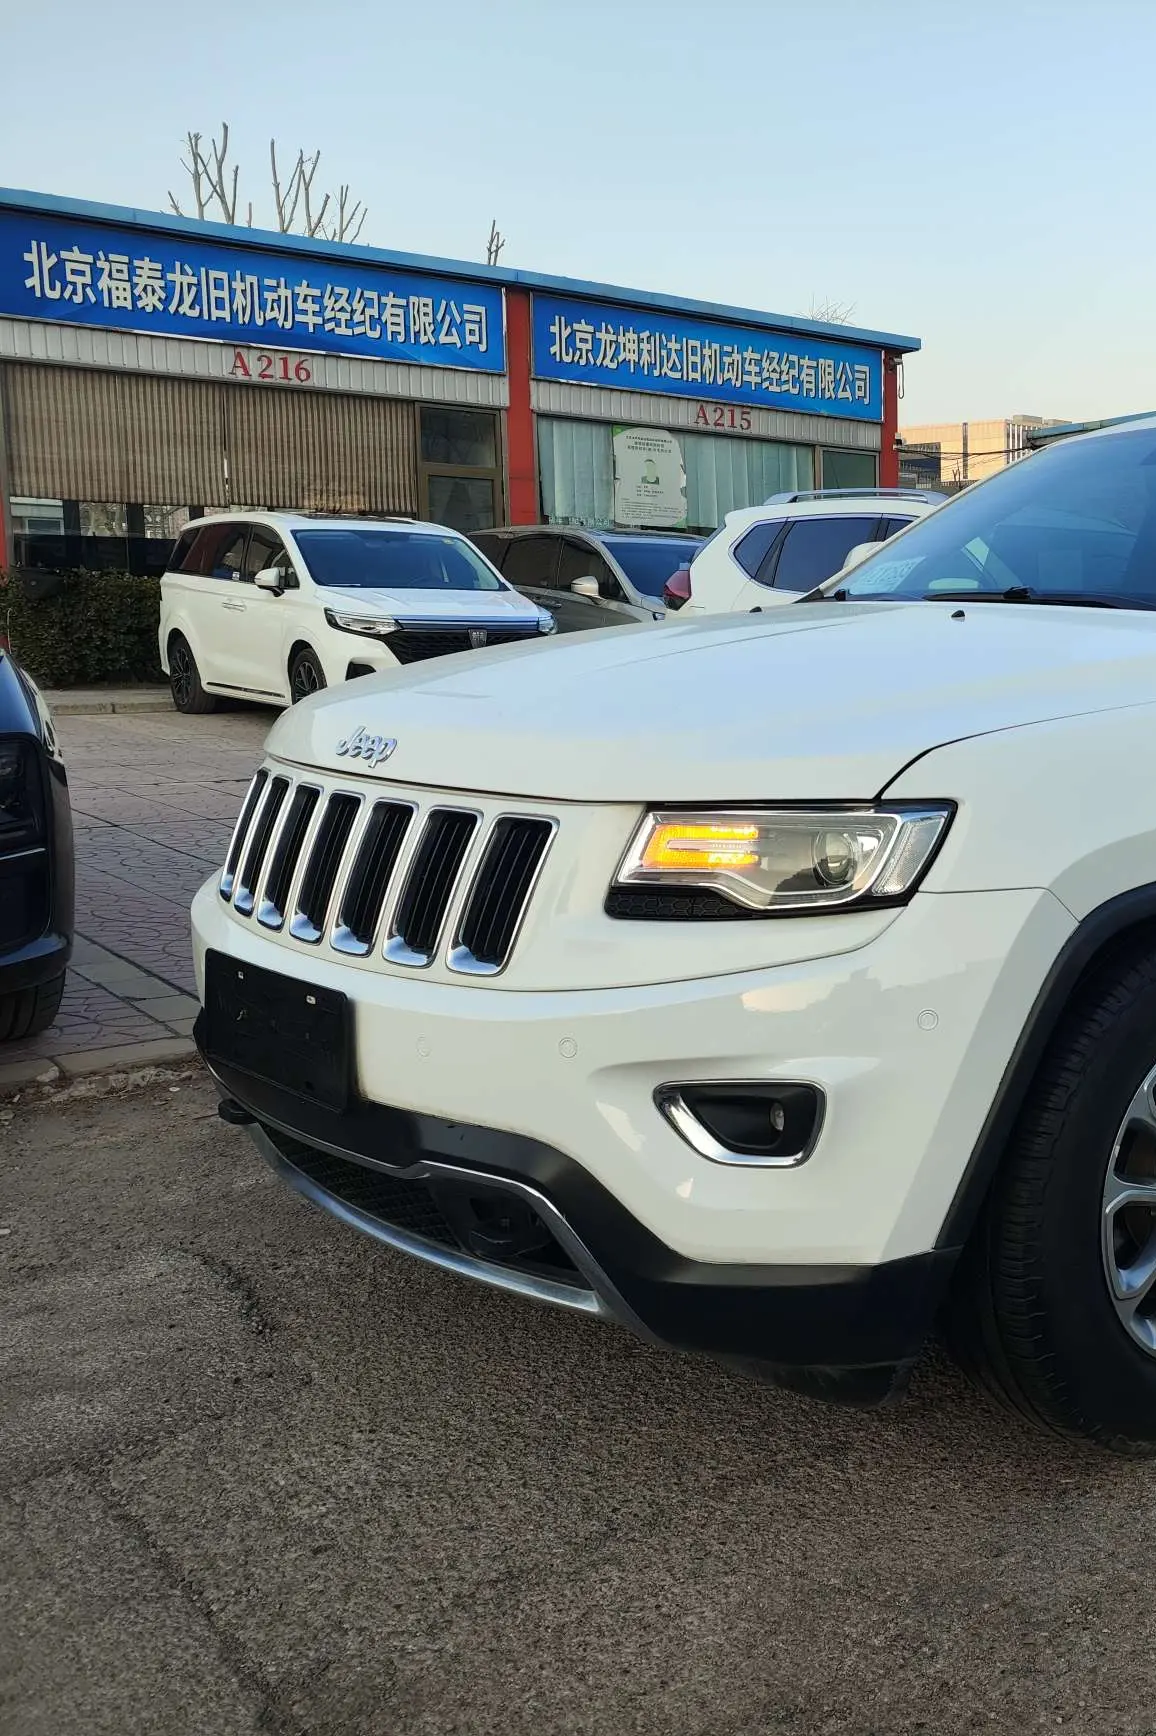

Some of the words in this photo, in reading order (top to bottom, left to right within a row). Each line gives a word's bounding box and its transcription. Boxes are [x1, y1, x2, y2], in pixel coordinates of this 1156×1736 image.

[23, 239, 488, 354] 北京福泰龙旧机动车经纪有限公司
[229, 350, 312, 383] A216
[549, 314, 871, 405] 北京龙坤利达旧机动车经纪有限公司
[694, 404, 752, 431] A215
[335, 725, 398, 769] Jeep
